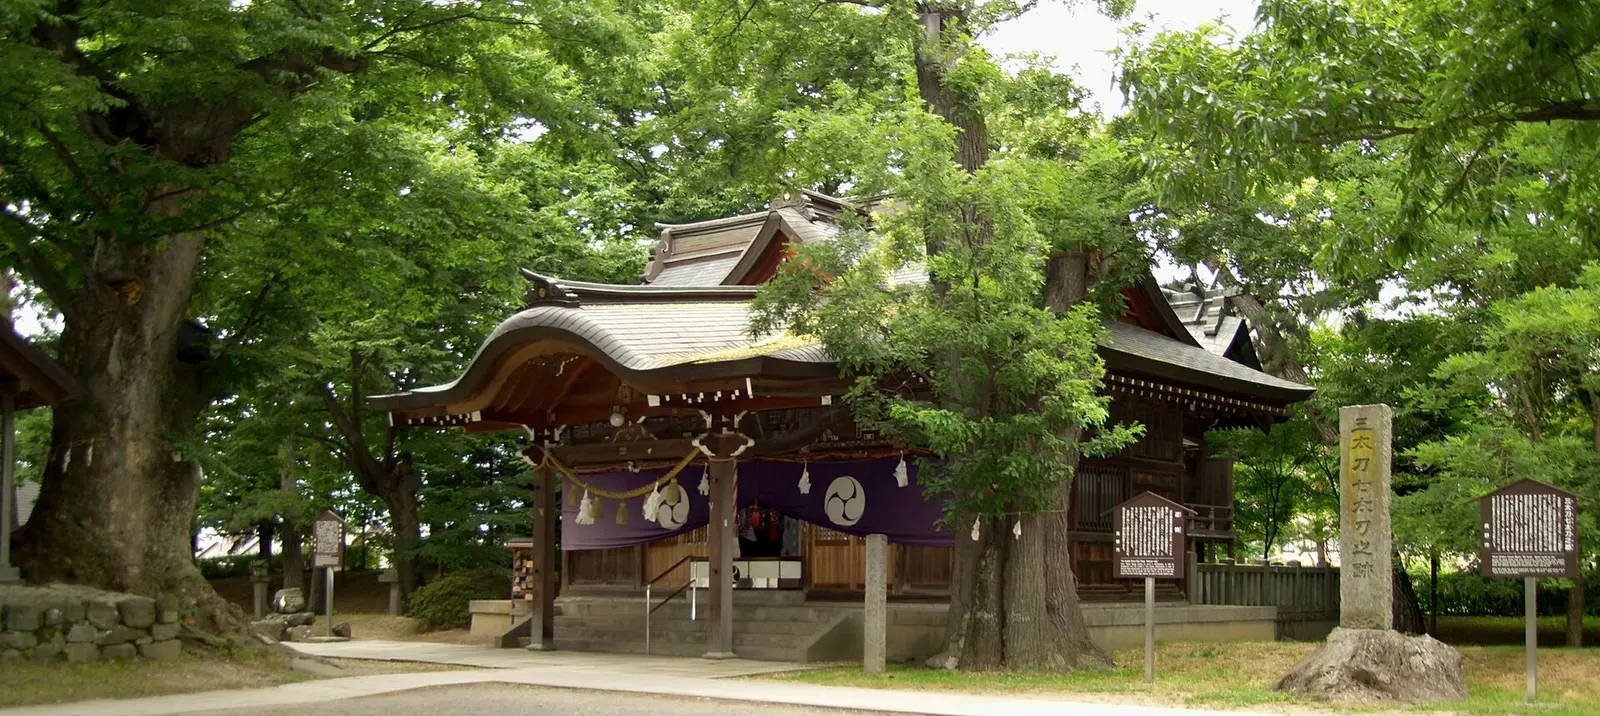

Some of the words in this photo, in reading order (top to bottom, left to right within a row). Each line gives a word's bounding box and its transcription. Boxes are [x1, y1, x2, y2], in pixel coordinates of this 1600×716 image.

[1351, 417, 1374, 579] 三太刀七太刀之跡
